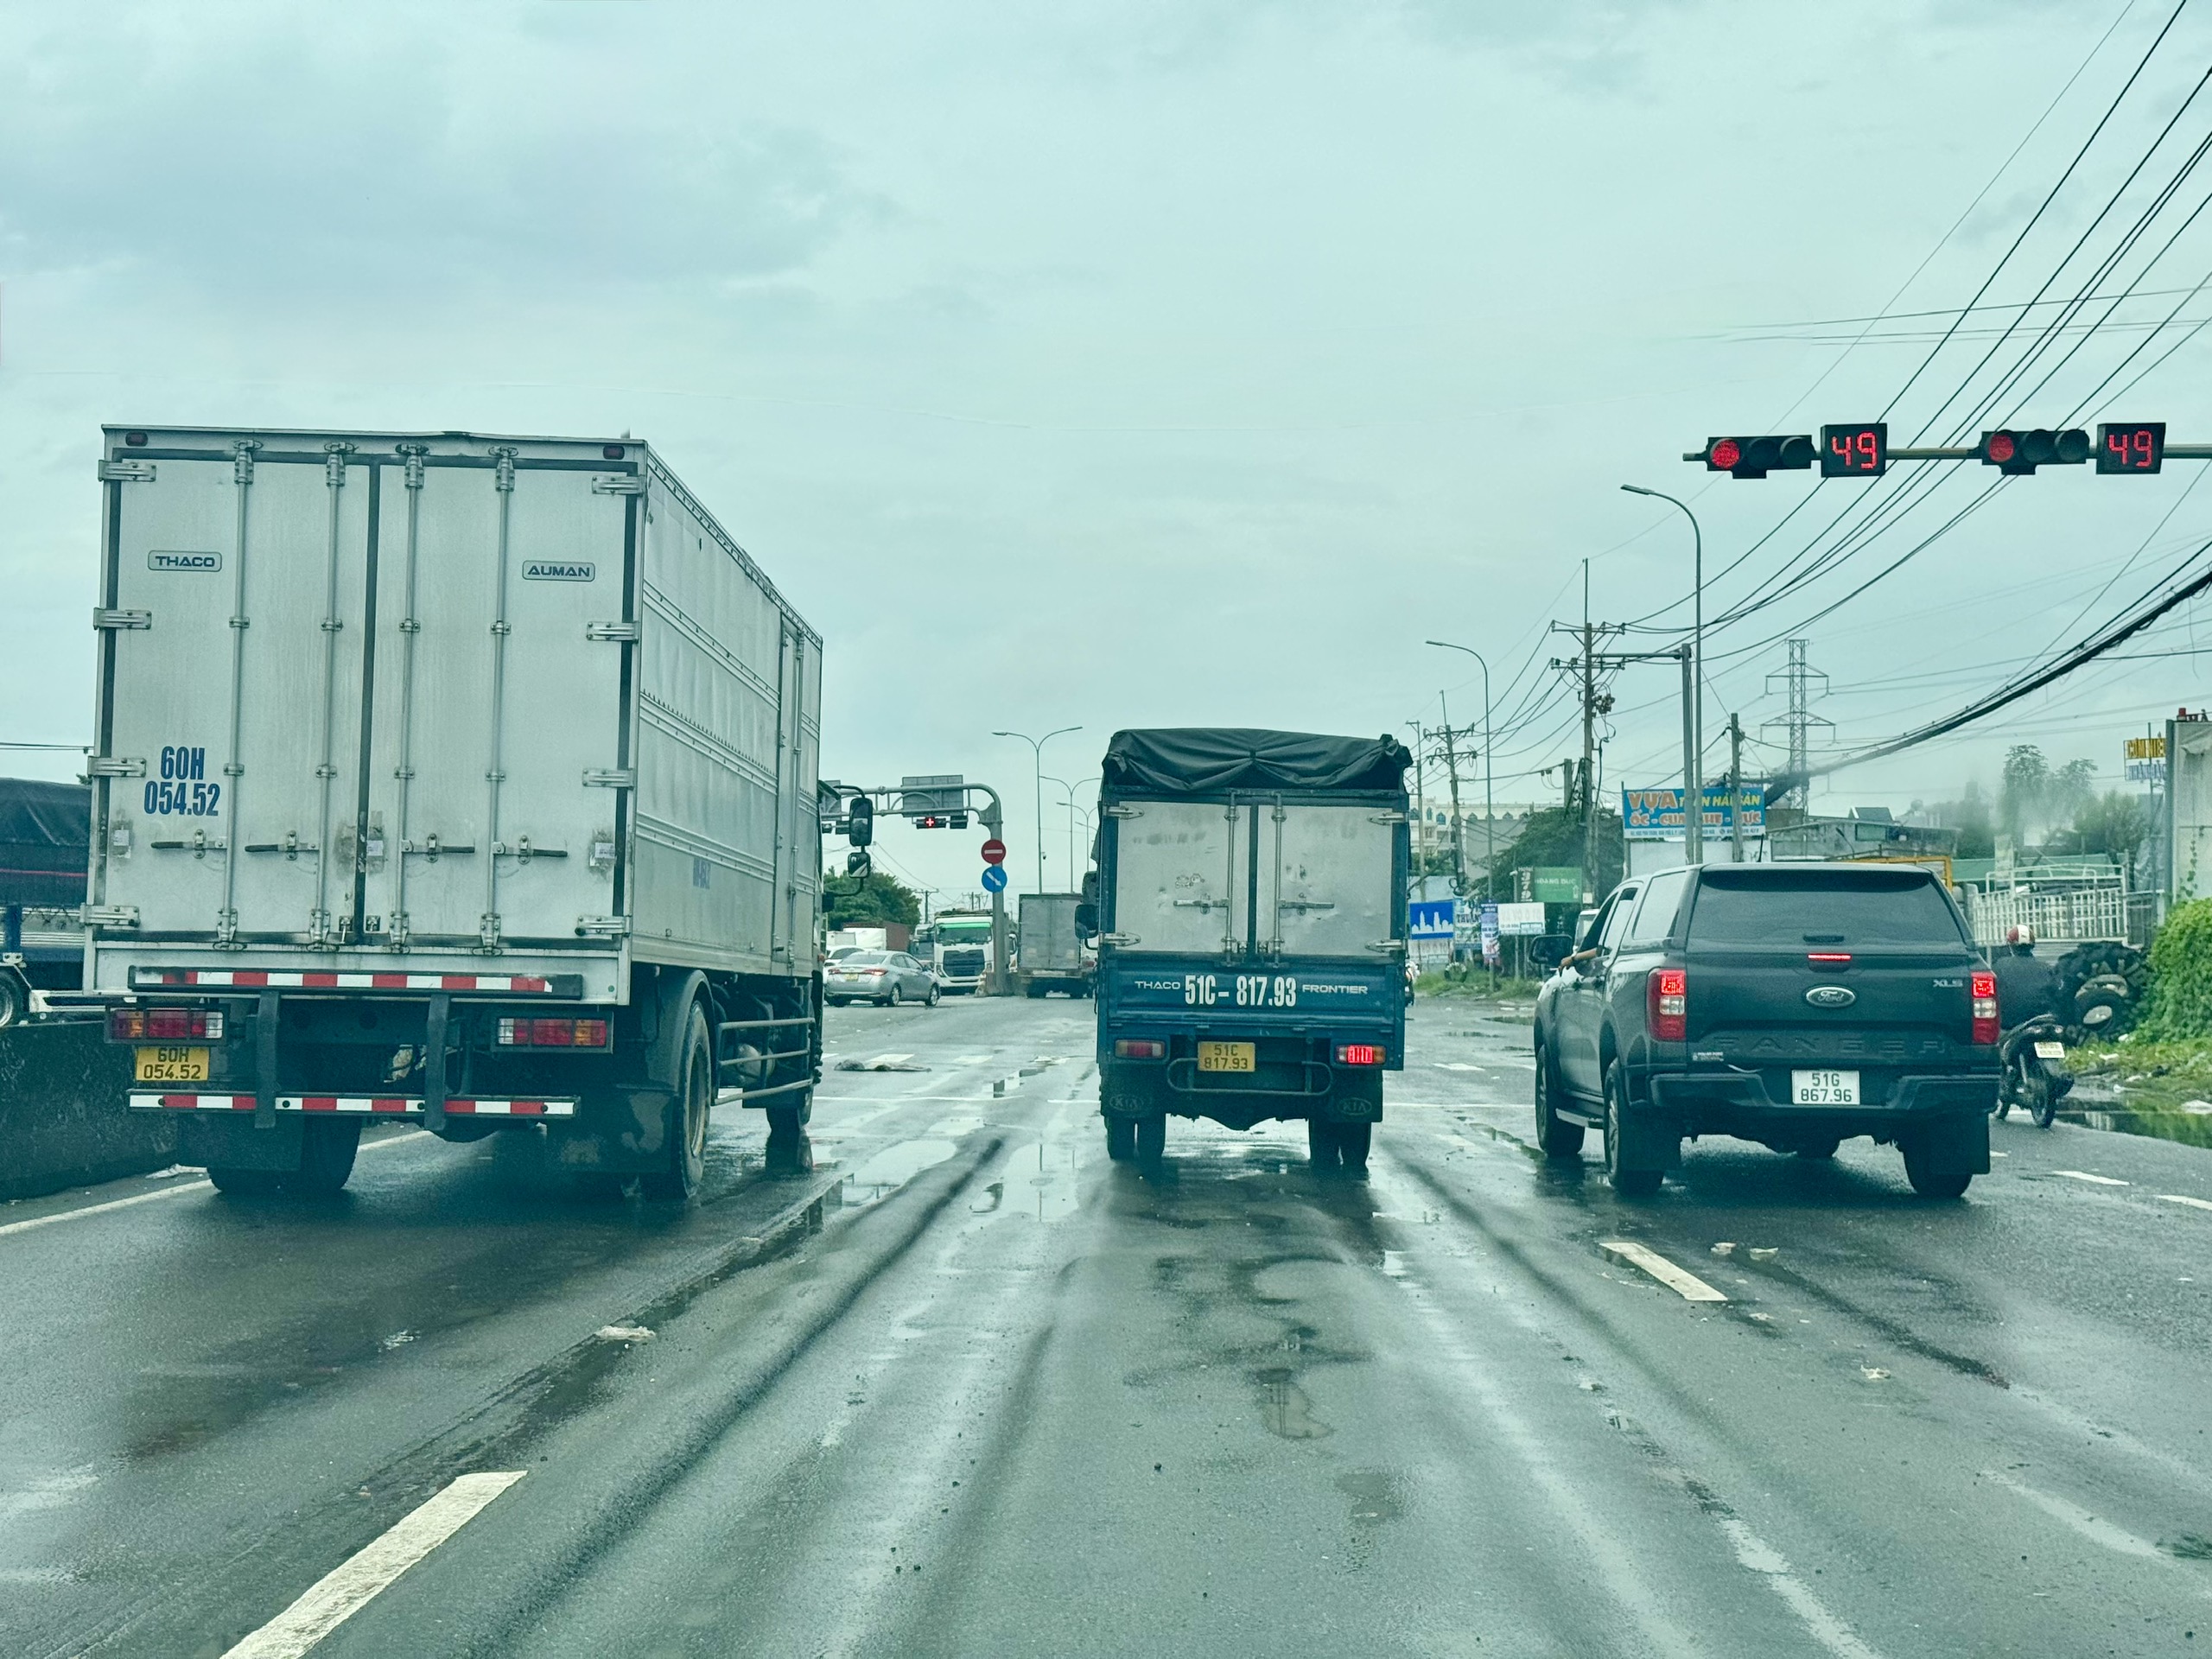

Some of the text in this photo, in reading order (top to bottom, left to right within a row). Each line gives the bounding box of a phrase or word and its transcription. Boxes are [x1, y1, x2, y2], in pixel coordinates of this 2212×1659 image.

[1832, 432, 1878, 469] 49
[2108, 430, 2152, 467] 49
[155, 556, 215, 567] THACO
[527, 565, 590, 577] AUMAN
[161, 746, 206, 780] 60H
[143, 780, 221, 817] 054.52
[1933, 979, 1963, 988] XLS
[1135, 981, 1181, 990] THACO
[1236, 976, 1297, 1007] 817.93
[1302, 983, 1369, 994] FRONTIER
[1818, 990, 1845, 1002] Ford
[157, 1047, 190, 1063] 60H
[1213, 1044, 1238, 1056] 51C
[1204, 1057, 1249, 1070] 817.93
[143, 1064, 201, 1079] 054.52
[1811, 1073, 1840, 1086] 51G
[1800, 1088, 1853, 1103] 867.96
